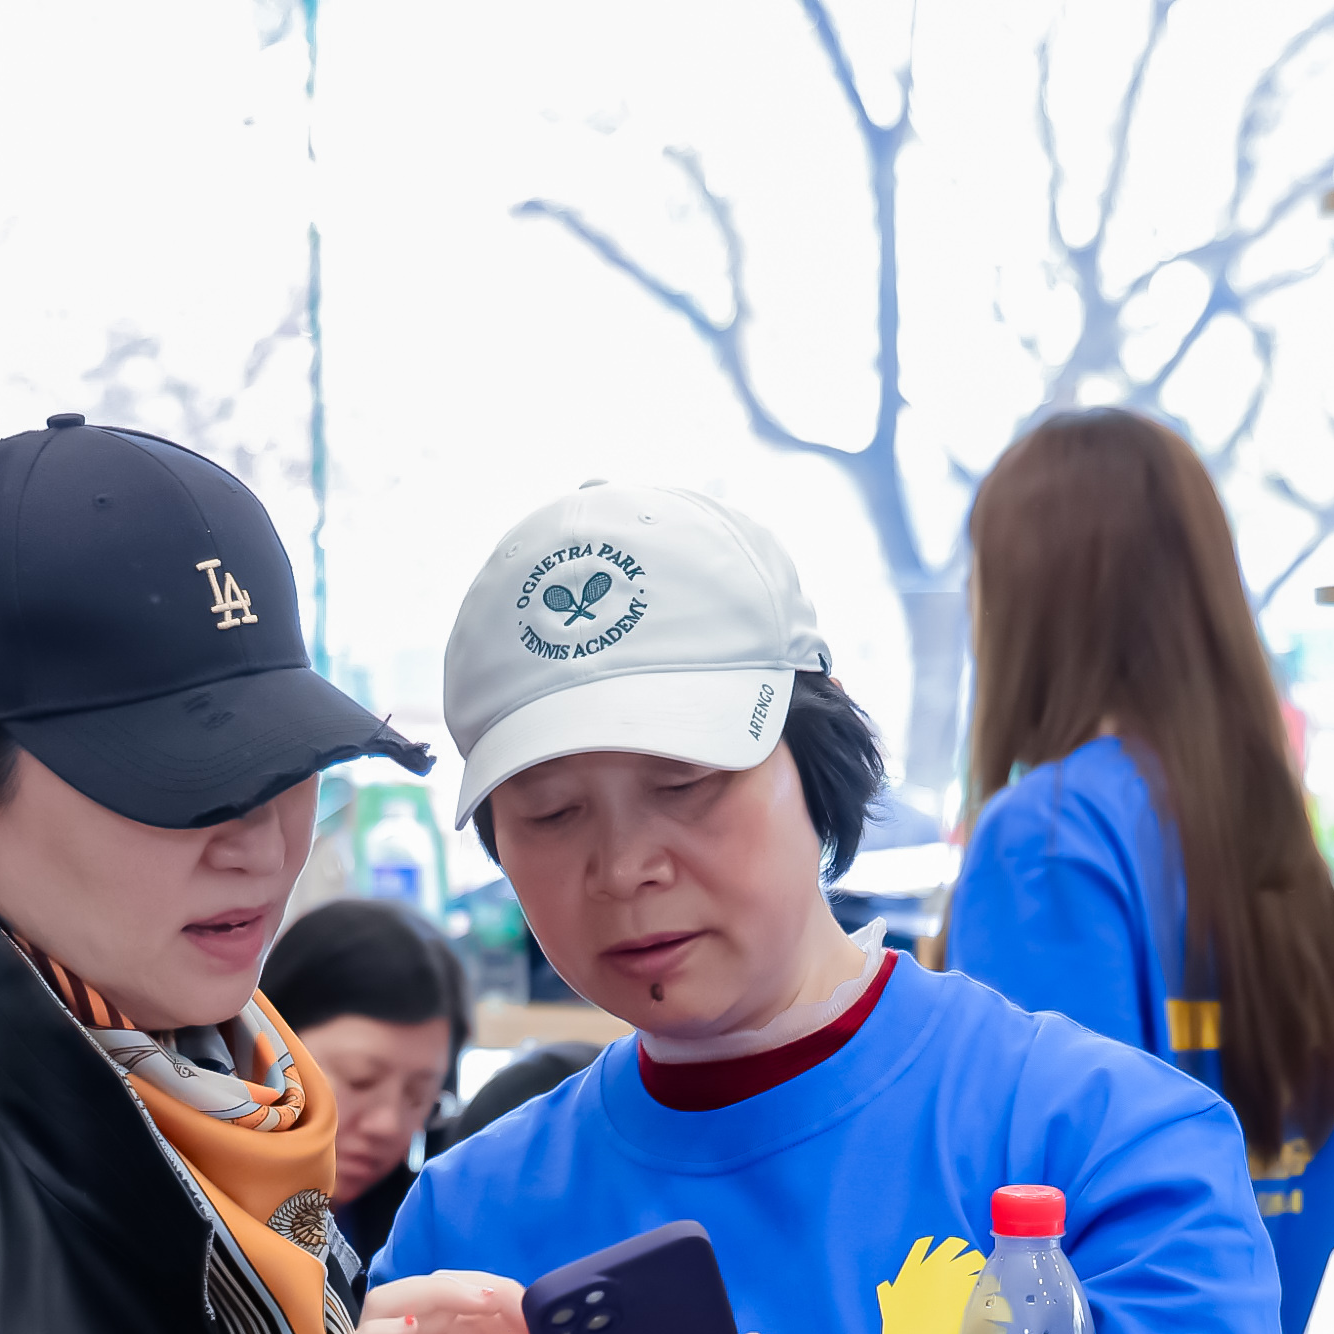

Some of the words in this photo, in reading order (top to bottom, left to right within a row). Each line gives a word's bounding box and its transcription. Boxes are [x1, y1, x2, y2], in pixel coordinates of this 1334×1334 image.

[195, 558, 259, 630] LA
[516, 543, 593, 609] OGNETRA
[596, 542, 647, 581] PARK
[520, 625, 571, 660] TENNIS
[572, 596, 648, 659] ACADEMY
[748, 683, 775, 742] ARTENGO
